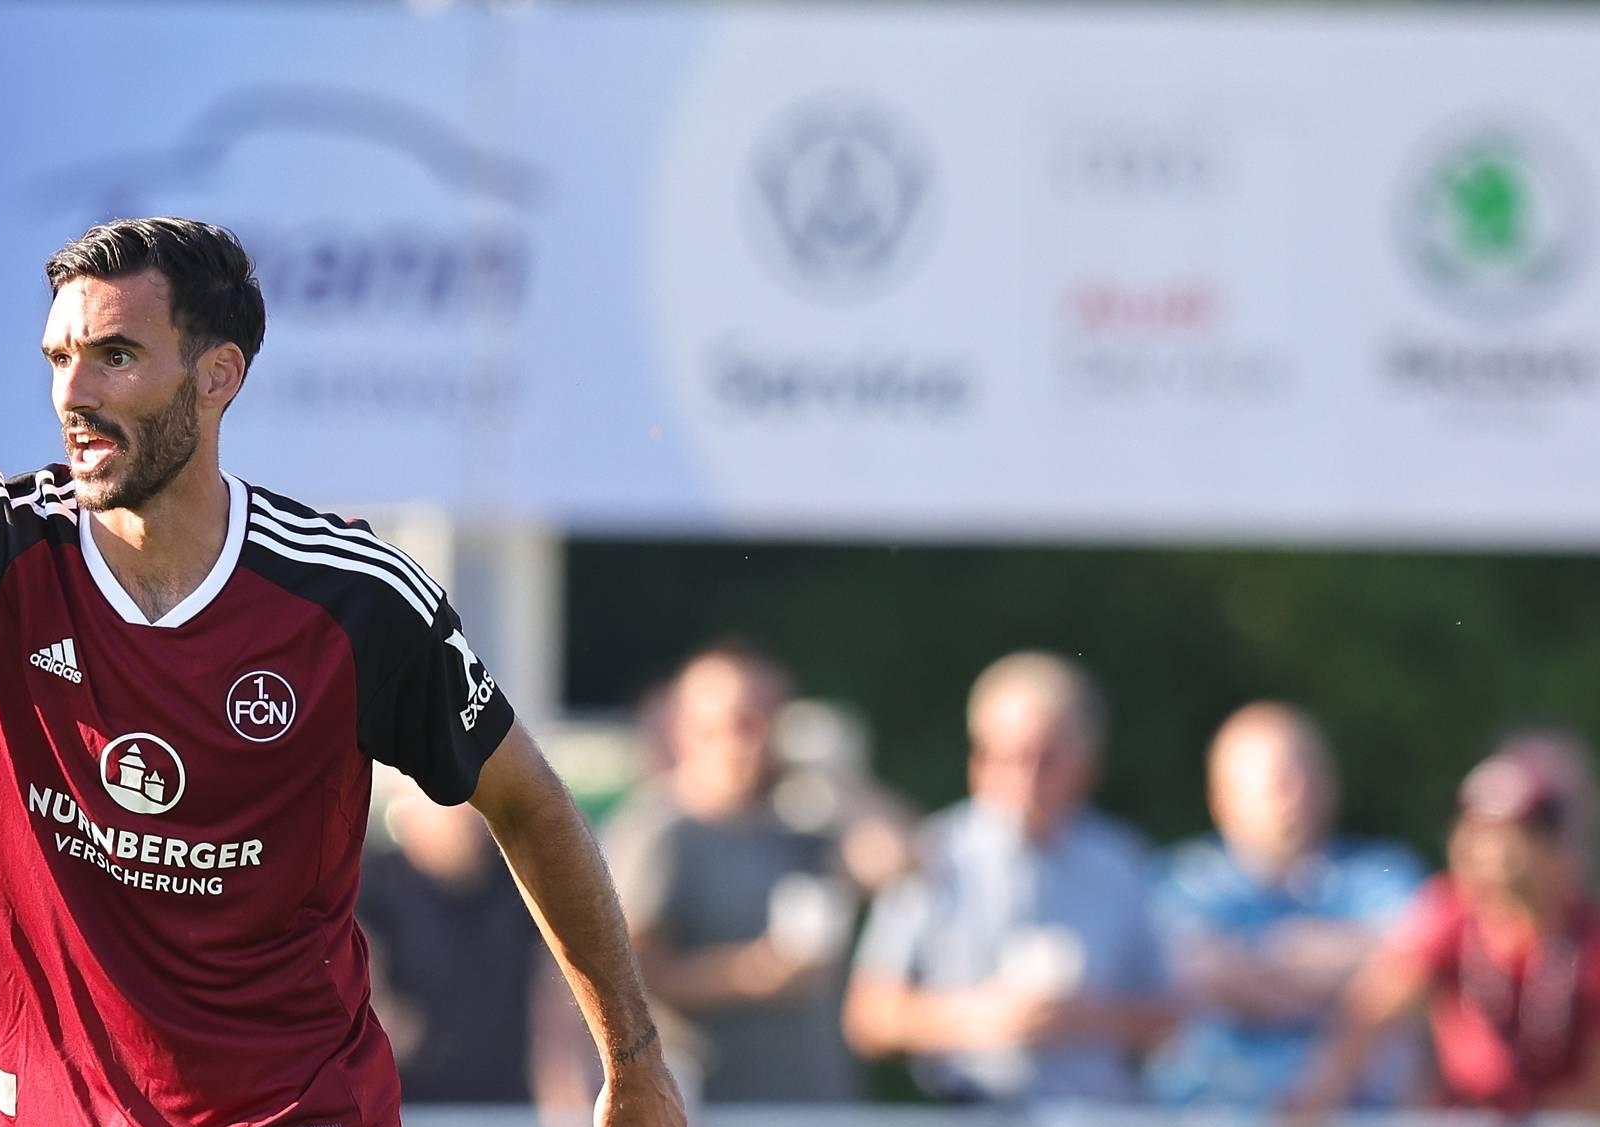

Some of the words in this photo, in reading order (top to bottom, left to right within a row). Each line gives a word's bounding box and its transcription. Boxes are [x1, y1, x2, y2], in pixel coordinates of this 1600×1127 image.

[29, 653, 83, 684] adidas
[253, 676, 269, 700] 1.
[235, 700, 287, 725] FCN
[28, 783, 264, 870] NÜRNBERGER
[54, 831, 224, 896] VERSICHERUNG
